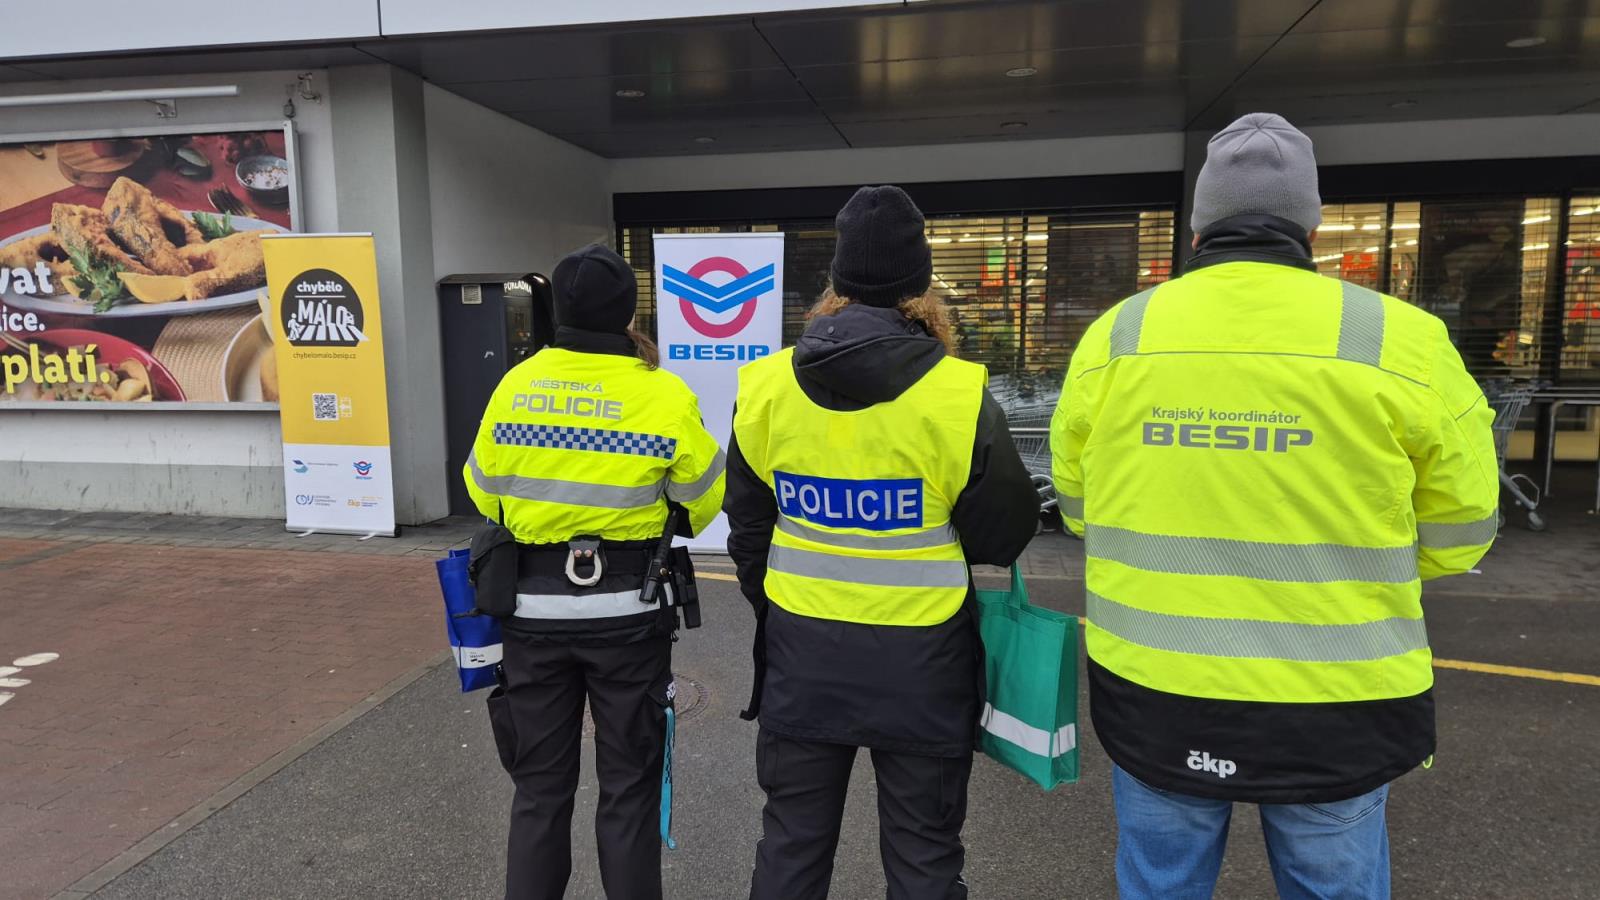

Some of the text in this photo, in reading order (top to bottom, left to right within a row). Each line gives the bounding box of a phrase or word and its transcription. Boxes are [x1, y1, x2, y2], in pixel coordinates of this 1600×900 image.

[296, 281, 343, 295] chybělo
[0, 305, 45, 332] ice.
[298, 299, 347, 326] MÁLO
[669, 344, 770, 361] BESIP
[530, 378, 603, 393] MĚSTSKÁ
[512, 393, 623, 420] POLICIE
[1152, 406, 1301, 424] Krajský koordinátor
[1142, 422, 1313, 453] BESIP
[779, 479, 918, 521] POLICIE
[1187, 749, 1237, 779] čkp
